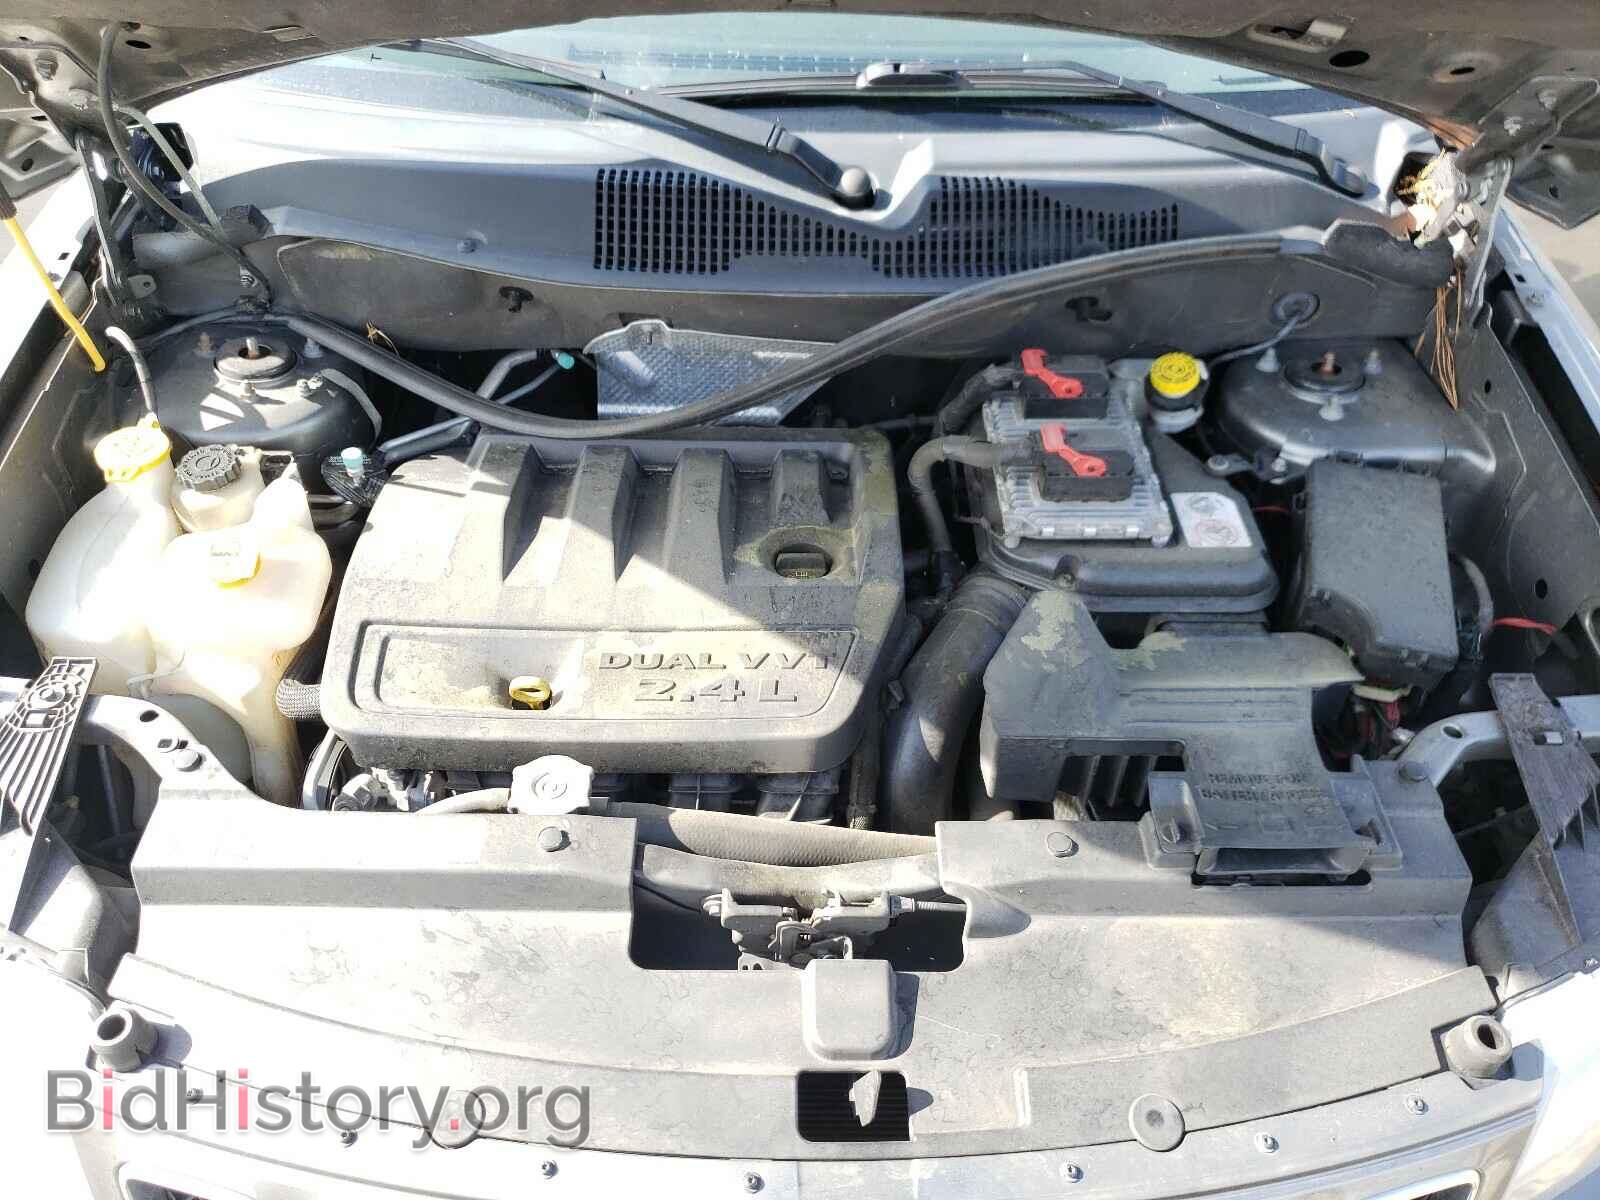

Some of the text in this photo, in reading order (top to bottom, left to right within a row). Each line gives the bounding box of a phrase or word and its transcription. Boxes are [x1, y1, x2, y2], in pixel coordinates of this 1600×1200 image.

[598, 652, 836, 670] DUAL VVT
[633, 678, 798, 703] 2.4L
